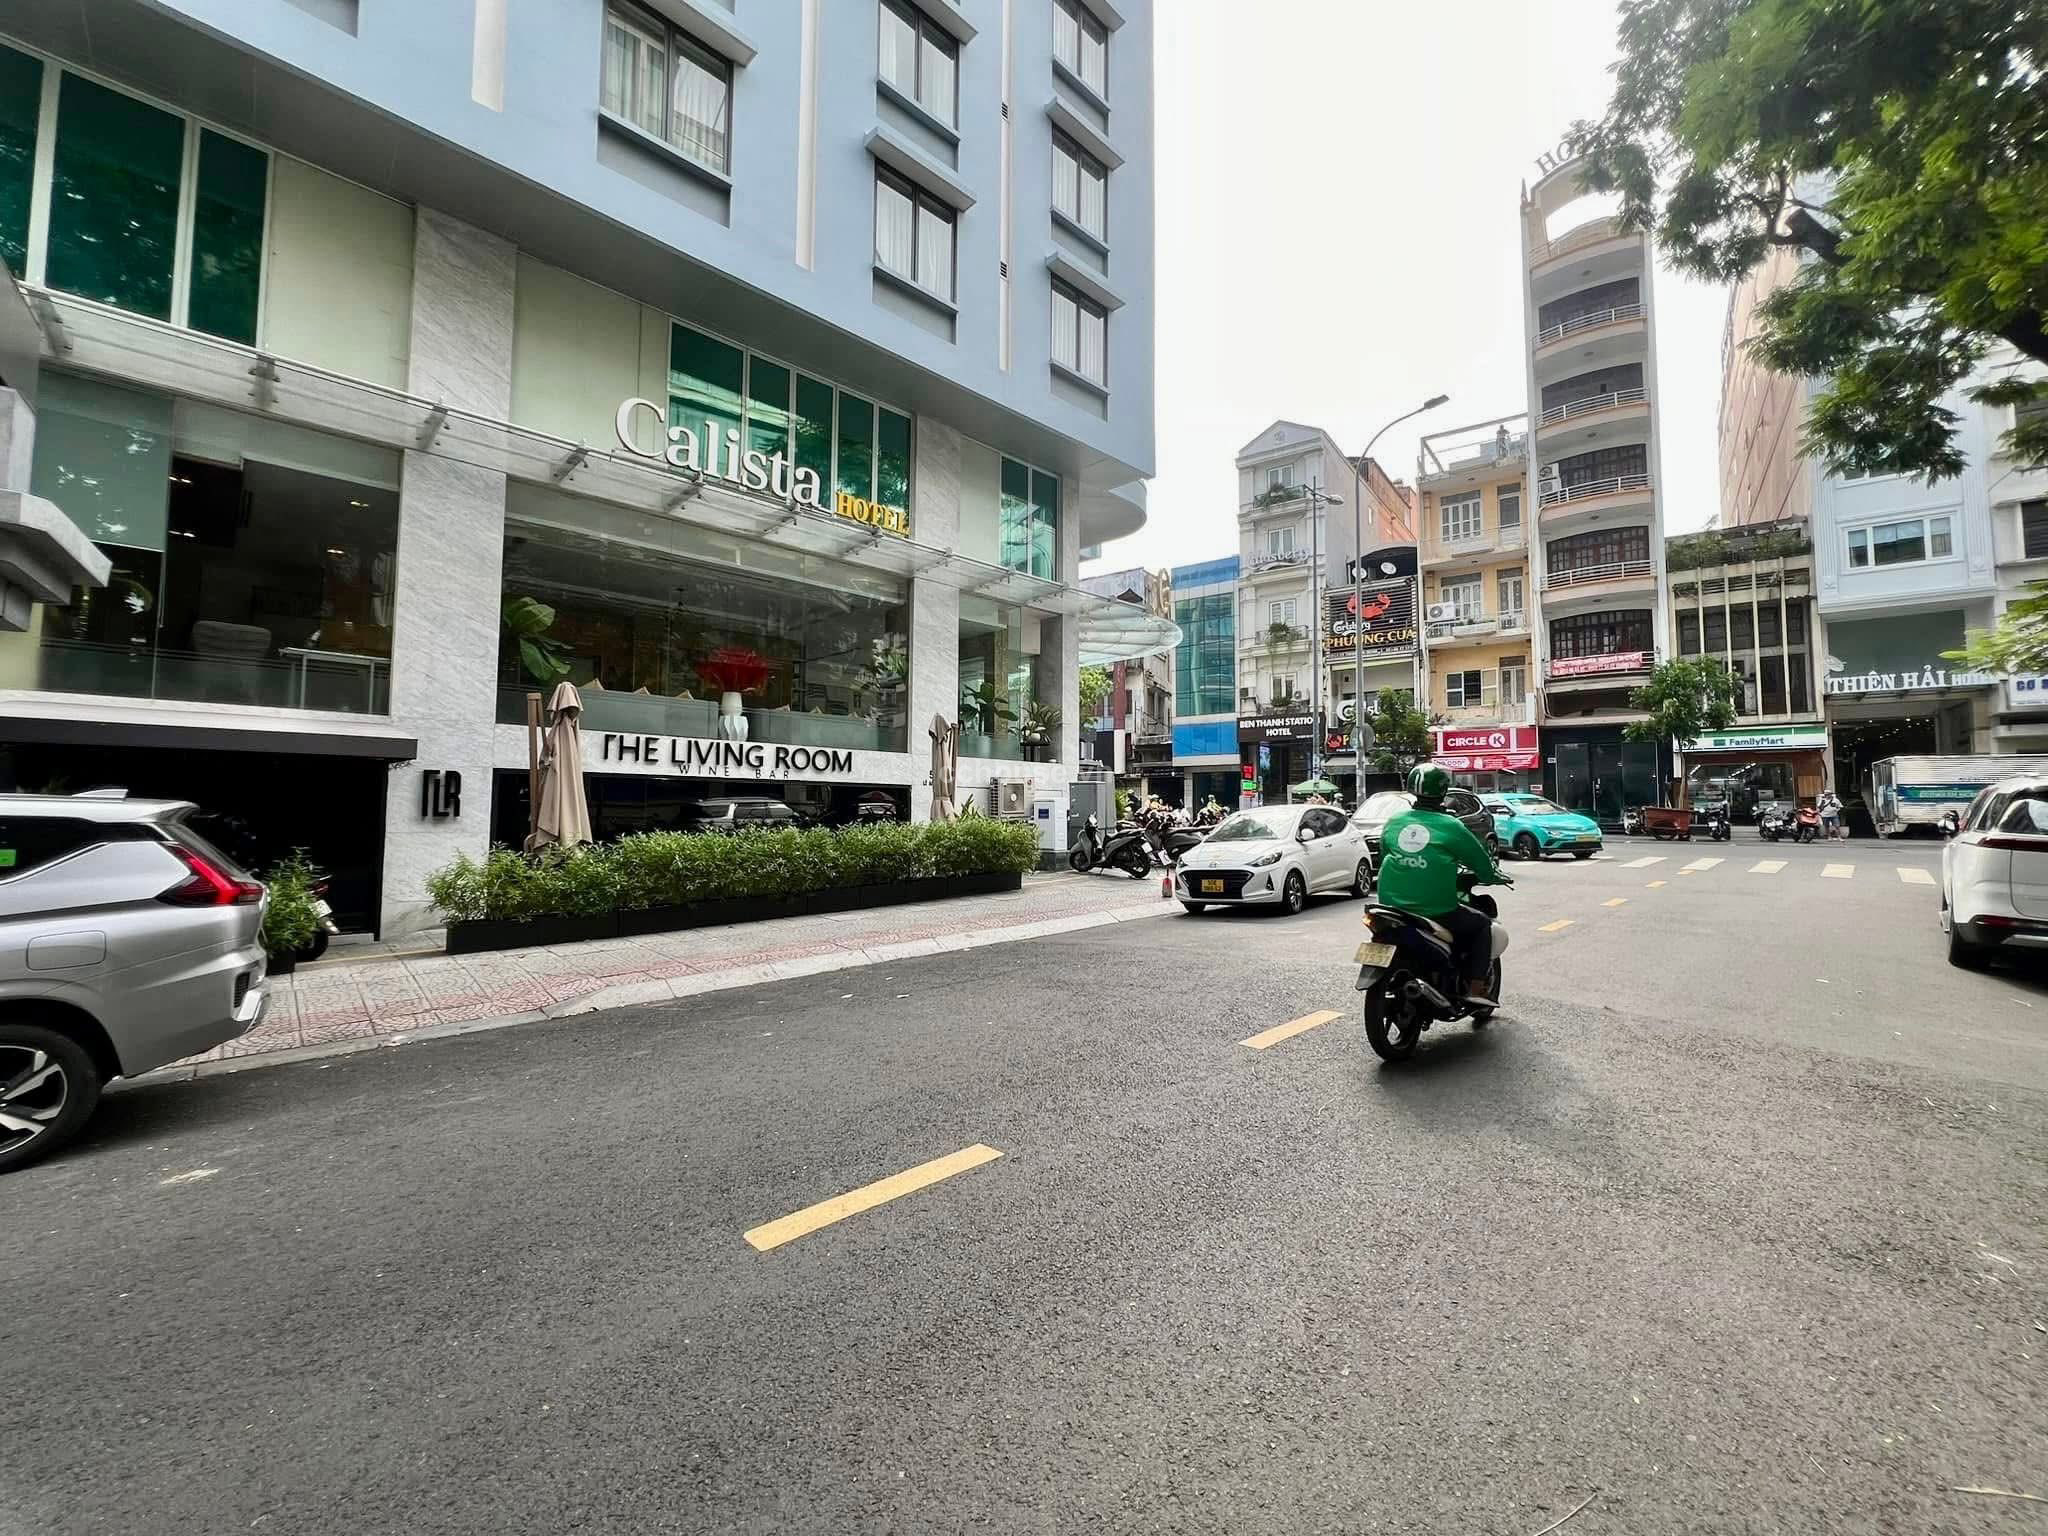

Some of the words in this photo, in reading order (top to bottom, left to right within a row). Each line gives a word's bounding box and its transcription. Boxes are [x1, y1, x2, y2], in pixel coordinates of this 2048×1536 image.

[615, 398, 821, 510] Calista
[836, 491, 911, 536] HOTEL
[1387, 629, 1414, 641] CUA
[1830, 671, 1896, 693] THIÊN
[1902, 664, 1946, 688] HẢI
[1239, 719, 1255, 729] BEN
[1256, 718, 1285, 728] THANH
[1266, 728, 1292, 737] HOTEL
[1447, 736, 1488, 747] CIRCLE
[1729, 737, 1785, 746] FamilyMart
[602, 734, 660, 763] THE
[671, 738, 764, 769] LIVING
[775, 746, 852, 774] ROOM
[679, 764, 730, 777] WINE
[756, 768, 789, 780] BAR
